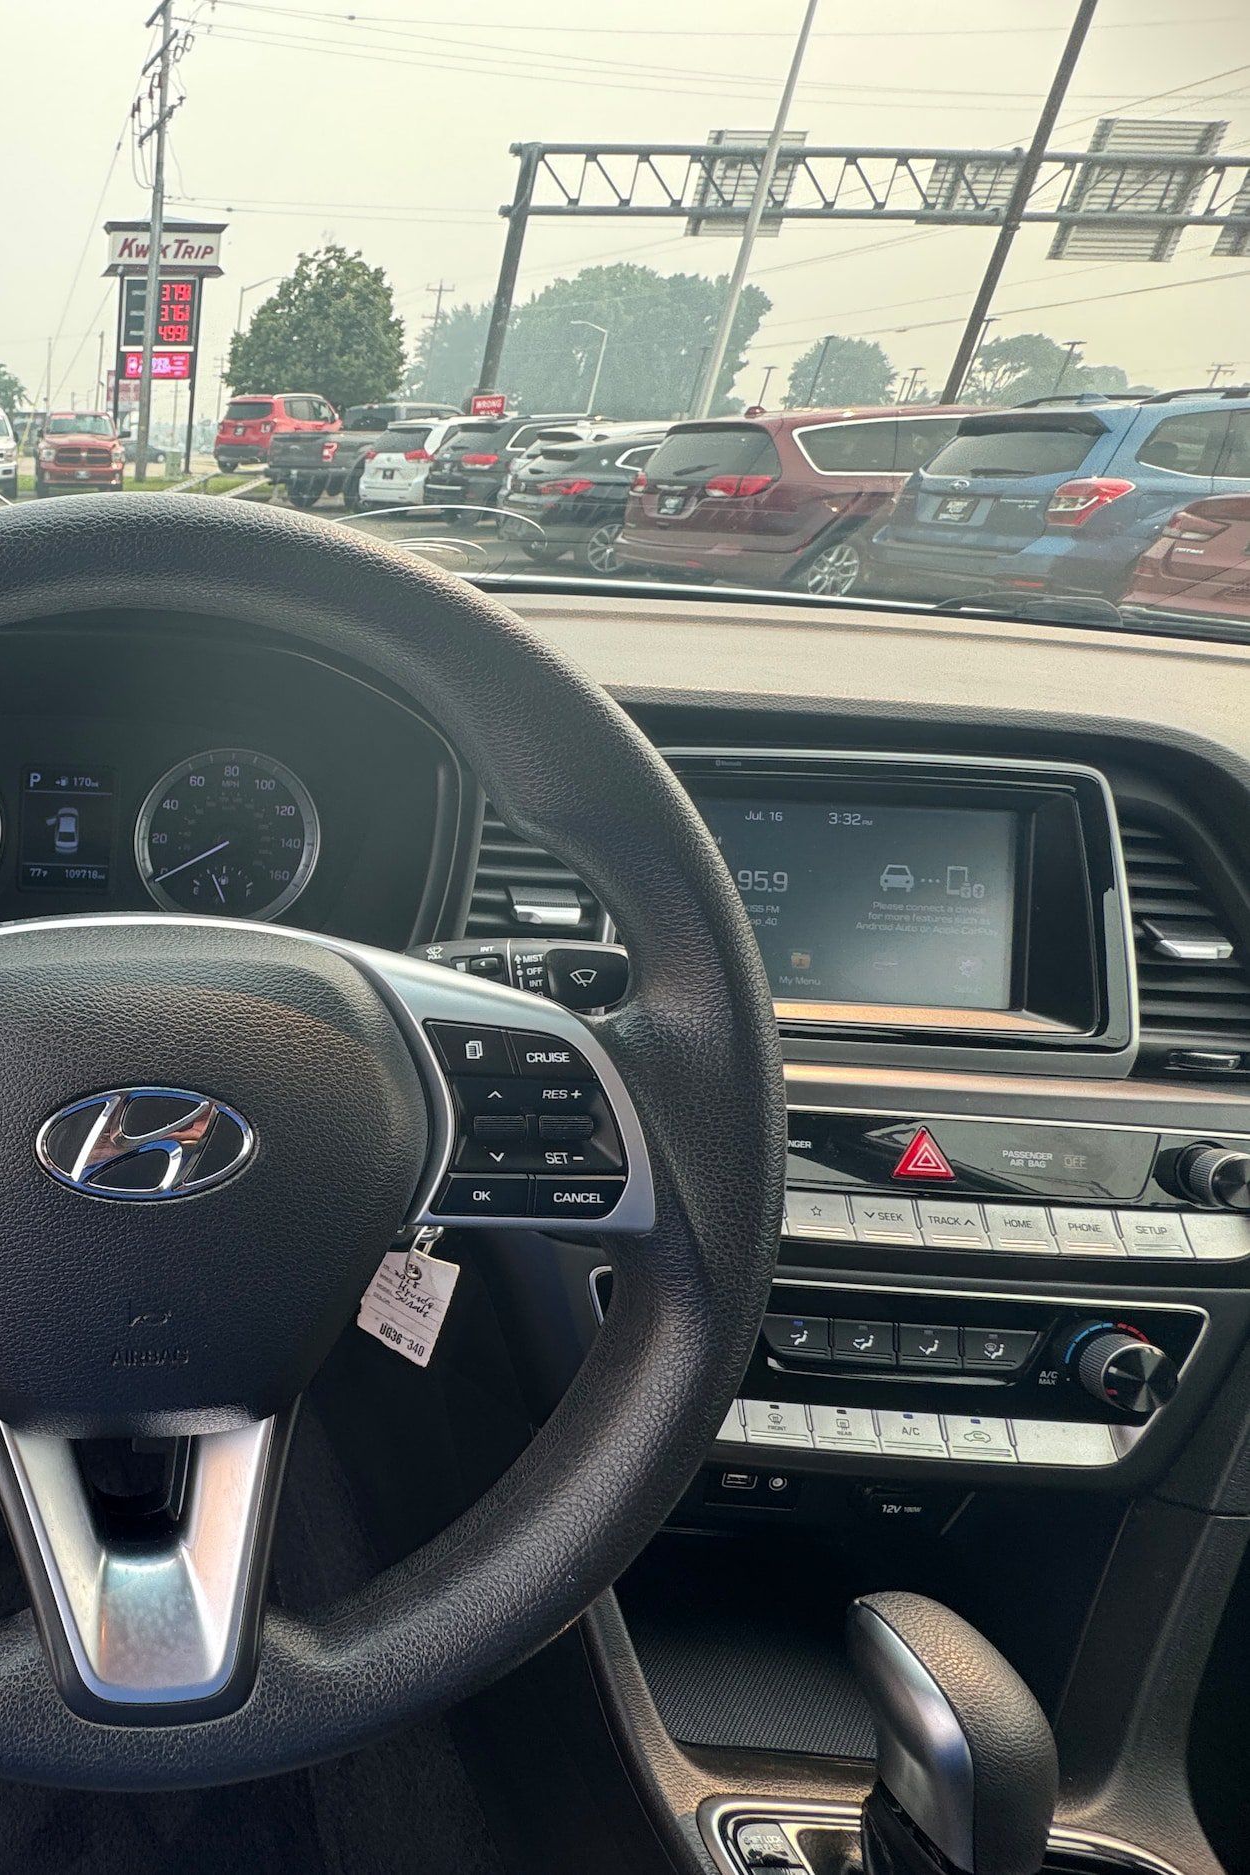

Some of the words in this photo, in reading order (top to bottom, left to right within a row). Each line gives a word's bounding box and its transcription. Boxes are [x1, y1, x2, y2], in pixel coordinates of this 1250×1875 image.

[118, 238, 172, 258] KWK
[174, 239, 214, 259] TRIP
[224, 766, 239, 777] 80
[30, 773, 40, 787] P
[189, 776, 204, 787] 60
[254, 780, 276, 791] 100
[162, 800, 178, 810] 40
[275, 805, 295, 816] 120
[745, 810, 764, 821] Jul.
[770, 811, 782, 822] 16
[152, 833, 167, 844] 20
[280, 838, 300, 849] 140
[270, 870, 290, 881] 160
[737, 870, 788, 892] 95.9
[766, 906, 780, 914] FM
[873, 902, 903, 911] Please
[906, 904, 944, 912] connect
[750, 918, 777, 926] op_40
[868, 912, 882, 920] for
[913, 914, 952, 923] features
[856, 922, 894, 931] Android
[896, 923, 918, 932] Auto
[522, 954, 544, 964] MIST
[526, 967, 543, 976] OFF
[779, 976, 792, 986] My
[796, 977, 820, 986] Menu
[526, 1052, 570, 1063] CRUISE
[788, 1140, 812, 1150] NGER
[1002, 1150, 1052, 1162] PASSENGER
[1010, 1159, 1024, 1168] AIR
[1028, 1160, 1046, 1168] BAG
[1064, 1156, 1086, 1168] OFF
[472, 1191, 490, 1201] OK
[553, 1192, 604, 1204] CANCEL
[878, 1212, 903, 1222] SEEK
[928, 1216, 961, 1226] TRACK
[1004, 1220, 1032, 1229] HOME
[1068, 1222, 1101, 1234] PHONE
[1135, 1225, 1167, 1236] SETUP
[1040, 1370, 1058, 1379] A/C
[1039, 1378, 1056, 1386] MAX
[902, 1427, 920, 1436] A/C
[882, 1504, 902, 1514] 12V
[764, 1835, 783, 1844] LOCK
